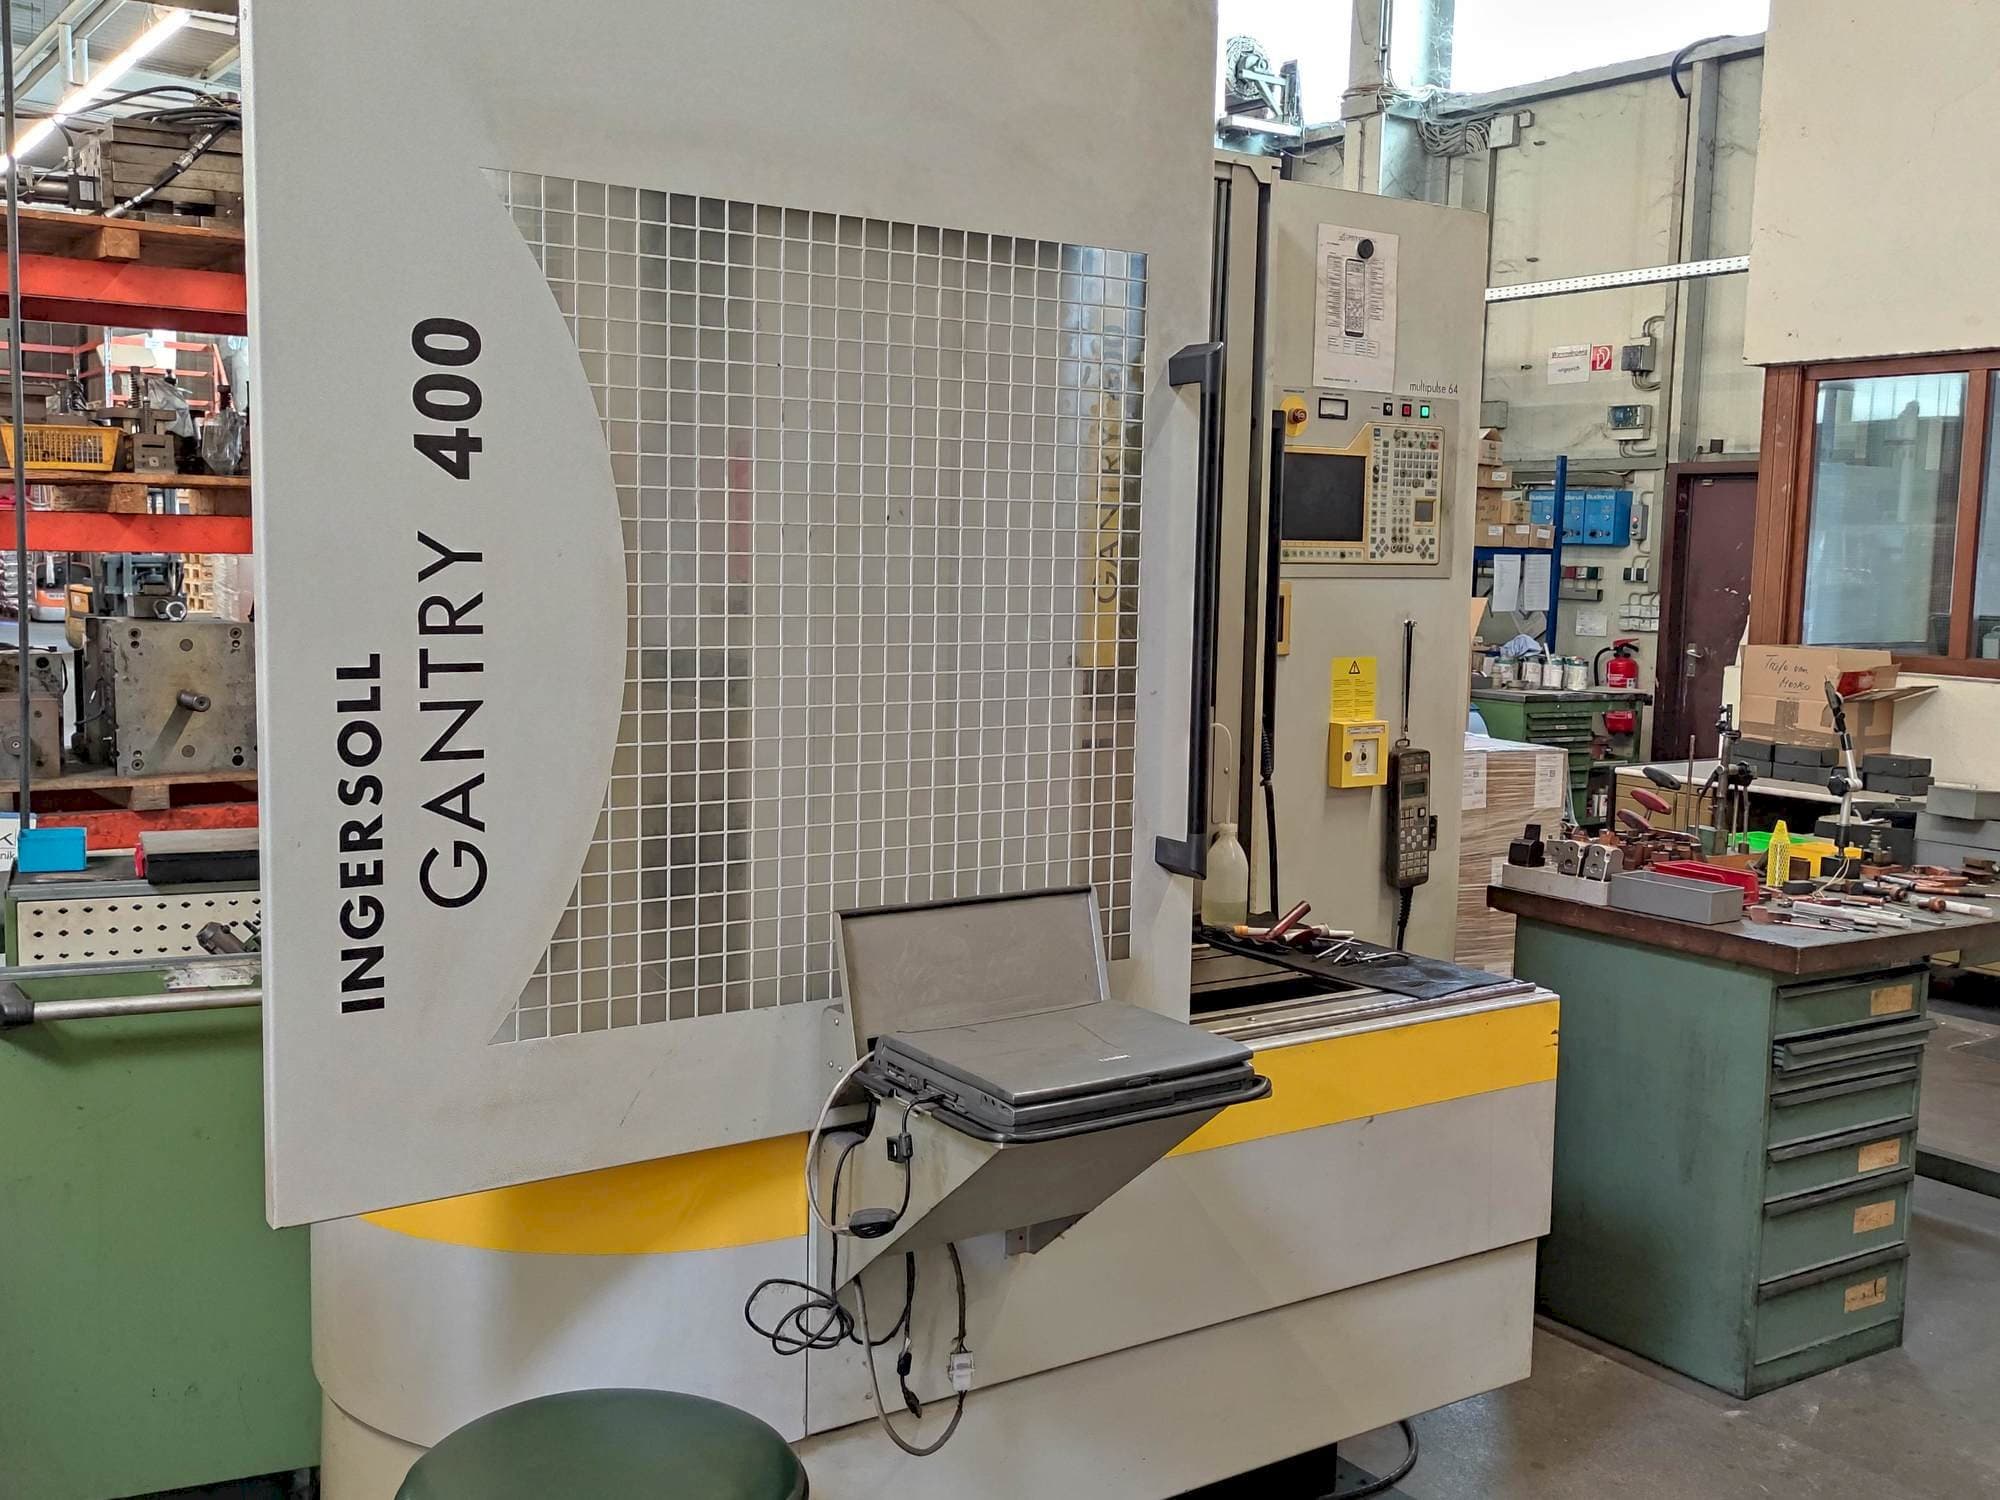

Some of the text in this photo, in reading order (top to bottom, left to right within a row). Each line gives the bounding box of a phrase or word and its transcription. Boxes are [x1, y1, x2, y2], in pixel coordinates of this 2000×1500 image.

[1409, 379, 1458, 397] multipulse 64
[411, 317, 488, 909] GANTRY 400
[335, 652, 385, 1015] INGERSOLL
